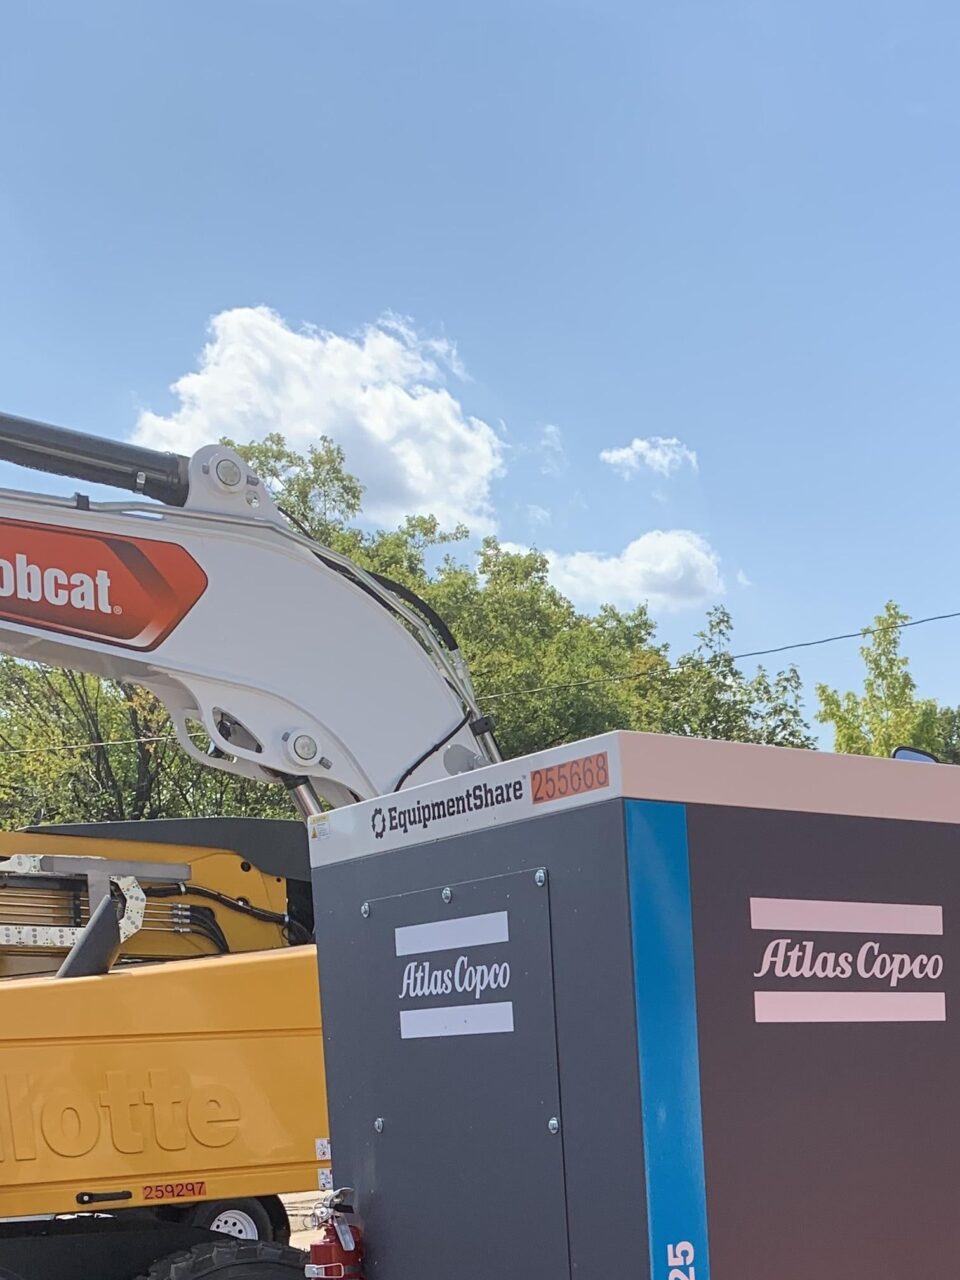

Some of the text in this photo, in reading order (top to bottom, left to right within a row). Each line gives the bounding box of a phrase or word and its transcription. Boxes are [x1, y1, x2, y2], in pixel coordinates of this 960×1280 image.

[532, 753, 608, 802] 255668
[388, 778, 523, 833] EquipmentShare
[398, 955, 511, 999] Atlas Copco
[753, 938, 944, 987] Atlas Copco
[0, 1070, 241, 1163] lotte
[143, 1181, 205, 1200] 259297
